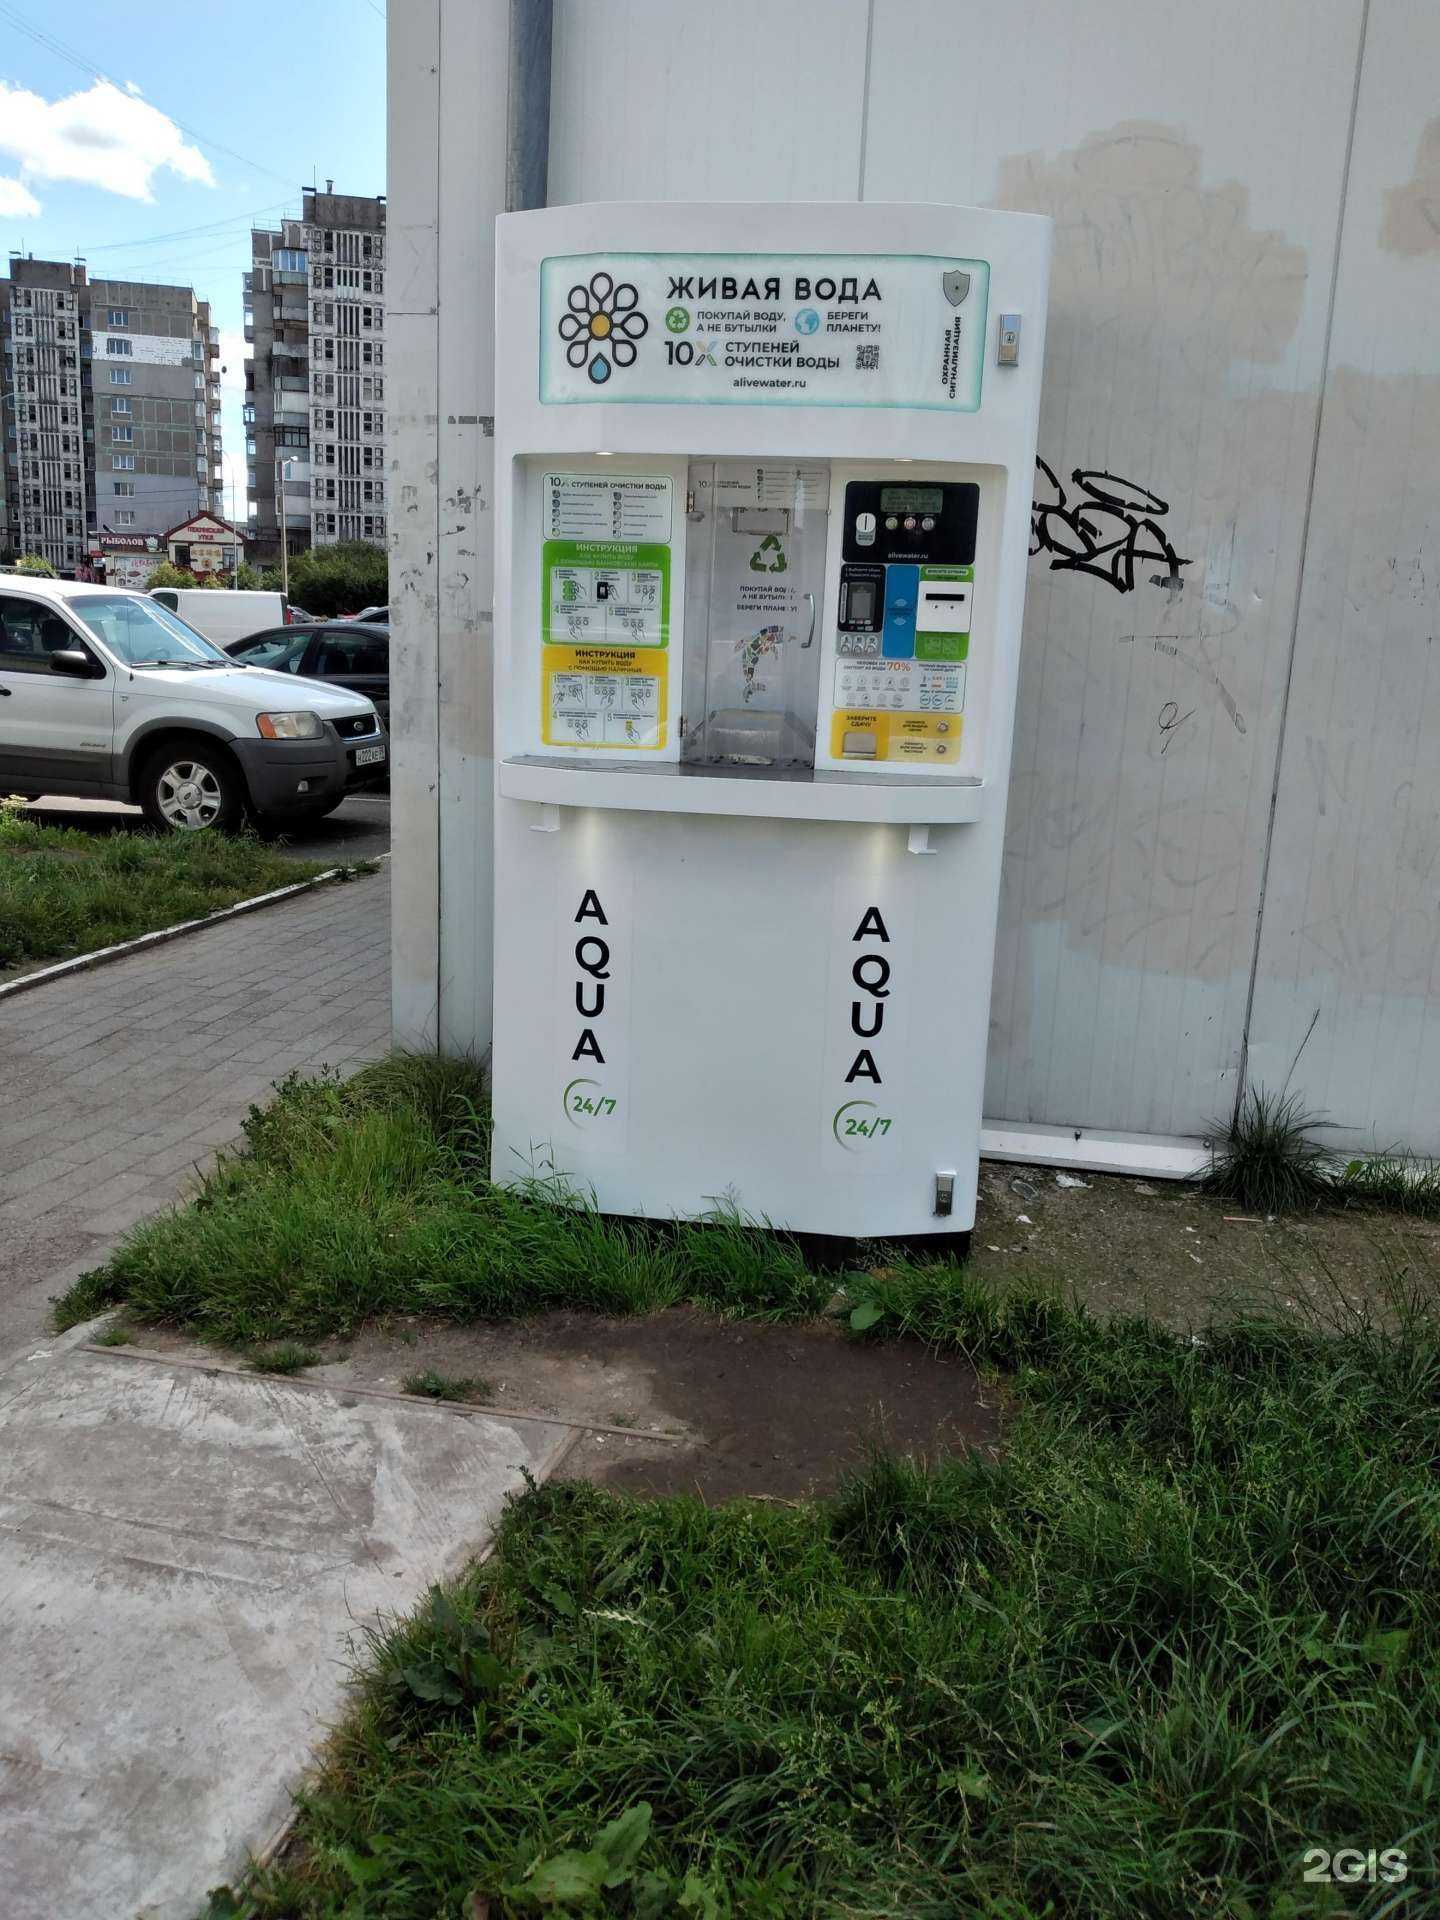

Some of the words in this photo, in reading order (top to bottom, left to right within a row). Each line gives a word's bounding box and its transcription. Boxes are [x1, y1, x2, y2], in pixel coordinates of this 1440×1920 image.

[666, 276, 781, 300] ЖИВАЯ
[794, 277, 882, 305] ВОДА
[697, 310, 751, 320] ПОКУПАЙ
[753, 311, 786, 322] ВОДУ,
[827, 311, 869, 321] БЕРЕГИ
[696, 323, 704, 332] А
[707, 323, 721, 332] НЕ
[724, 323, 777, 333] БУТЫЛКИ
[826, 323, 881, 333] ПЛАНЕТУ!
[725, 339, 800, 353] СТУПЕНЕЙ
[941, 329, 952, 385] ОХРАННАЯ
[949, 316, 962, 399] СИГНАЛИЗАЦИЯ
[724, 356, 792, 368] ОЧИСТКИ
[796, 356, 840, 370] ВОДЫ
[732, 377, 807, 388] alivewater.ru
[571, 480, 609, 489] СТУПЕНЕЙ
[101, 536, 144, 546] РЫБОЛОВ
[575, 543, 639, 554] ИНСТРУКЦИЯ
[887, 551, 929, 559] alivewater.ru
[739, 585, 773, 593] ПОКУПАЙ
[575, 649, 636, 659] ИНСТРУКЦИЯ
[887, 661, 912, 672] 70%
[571, 889, 611, 1064] AQUA
[844, 906, 891, 1084] AQUA
[572, 1095, 617, 1117] 24/7
[844, 1116, 892, 1138] 24/7
